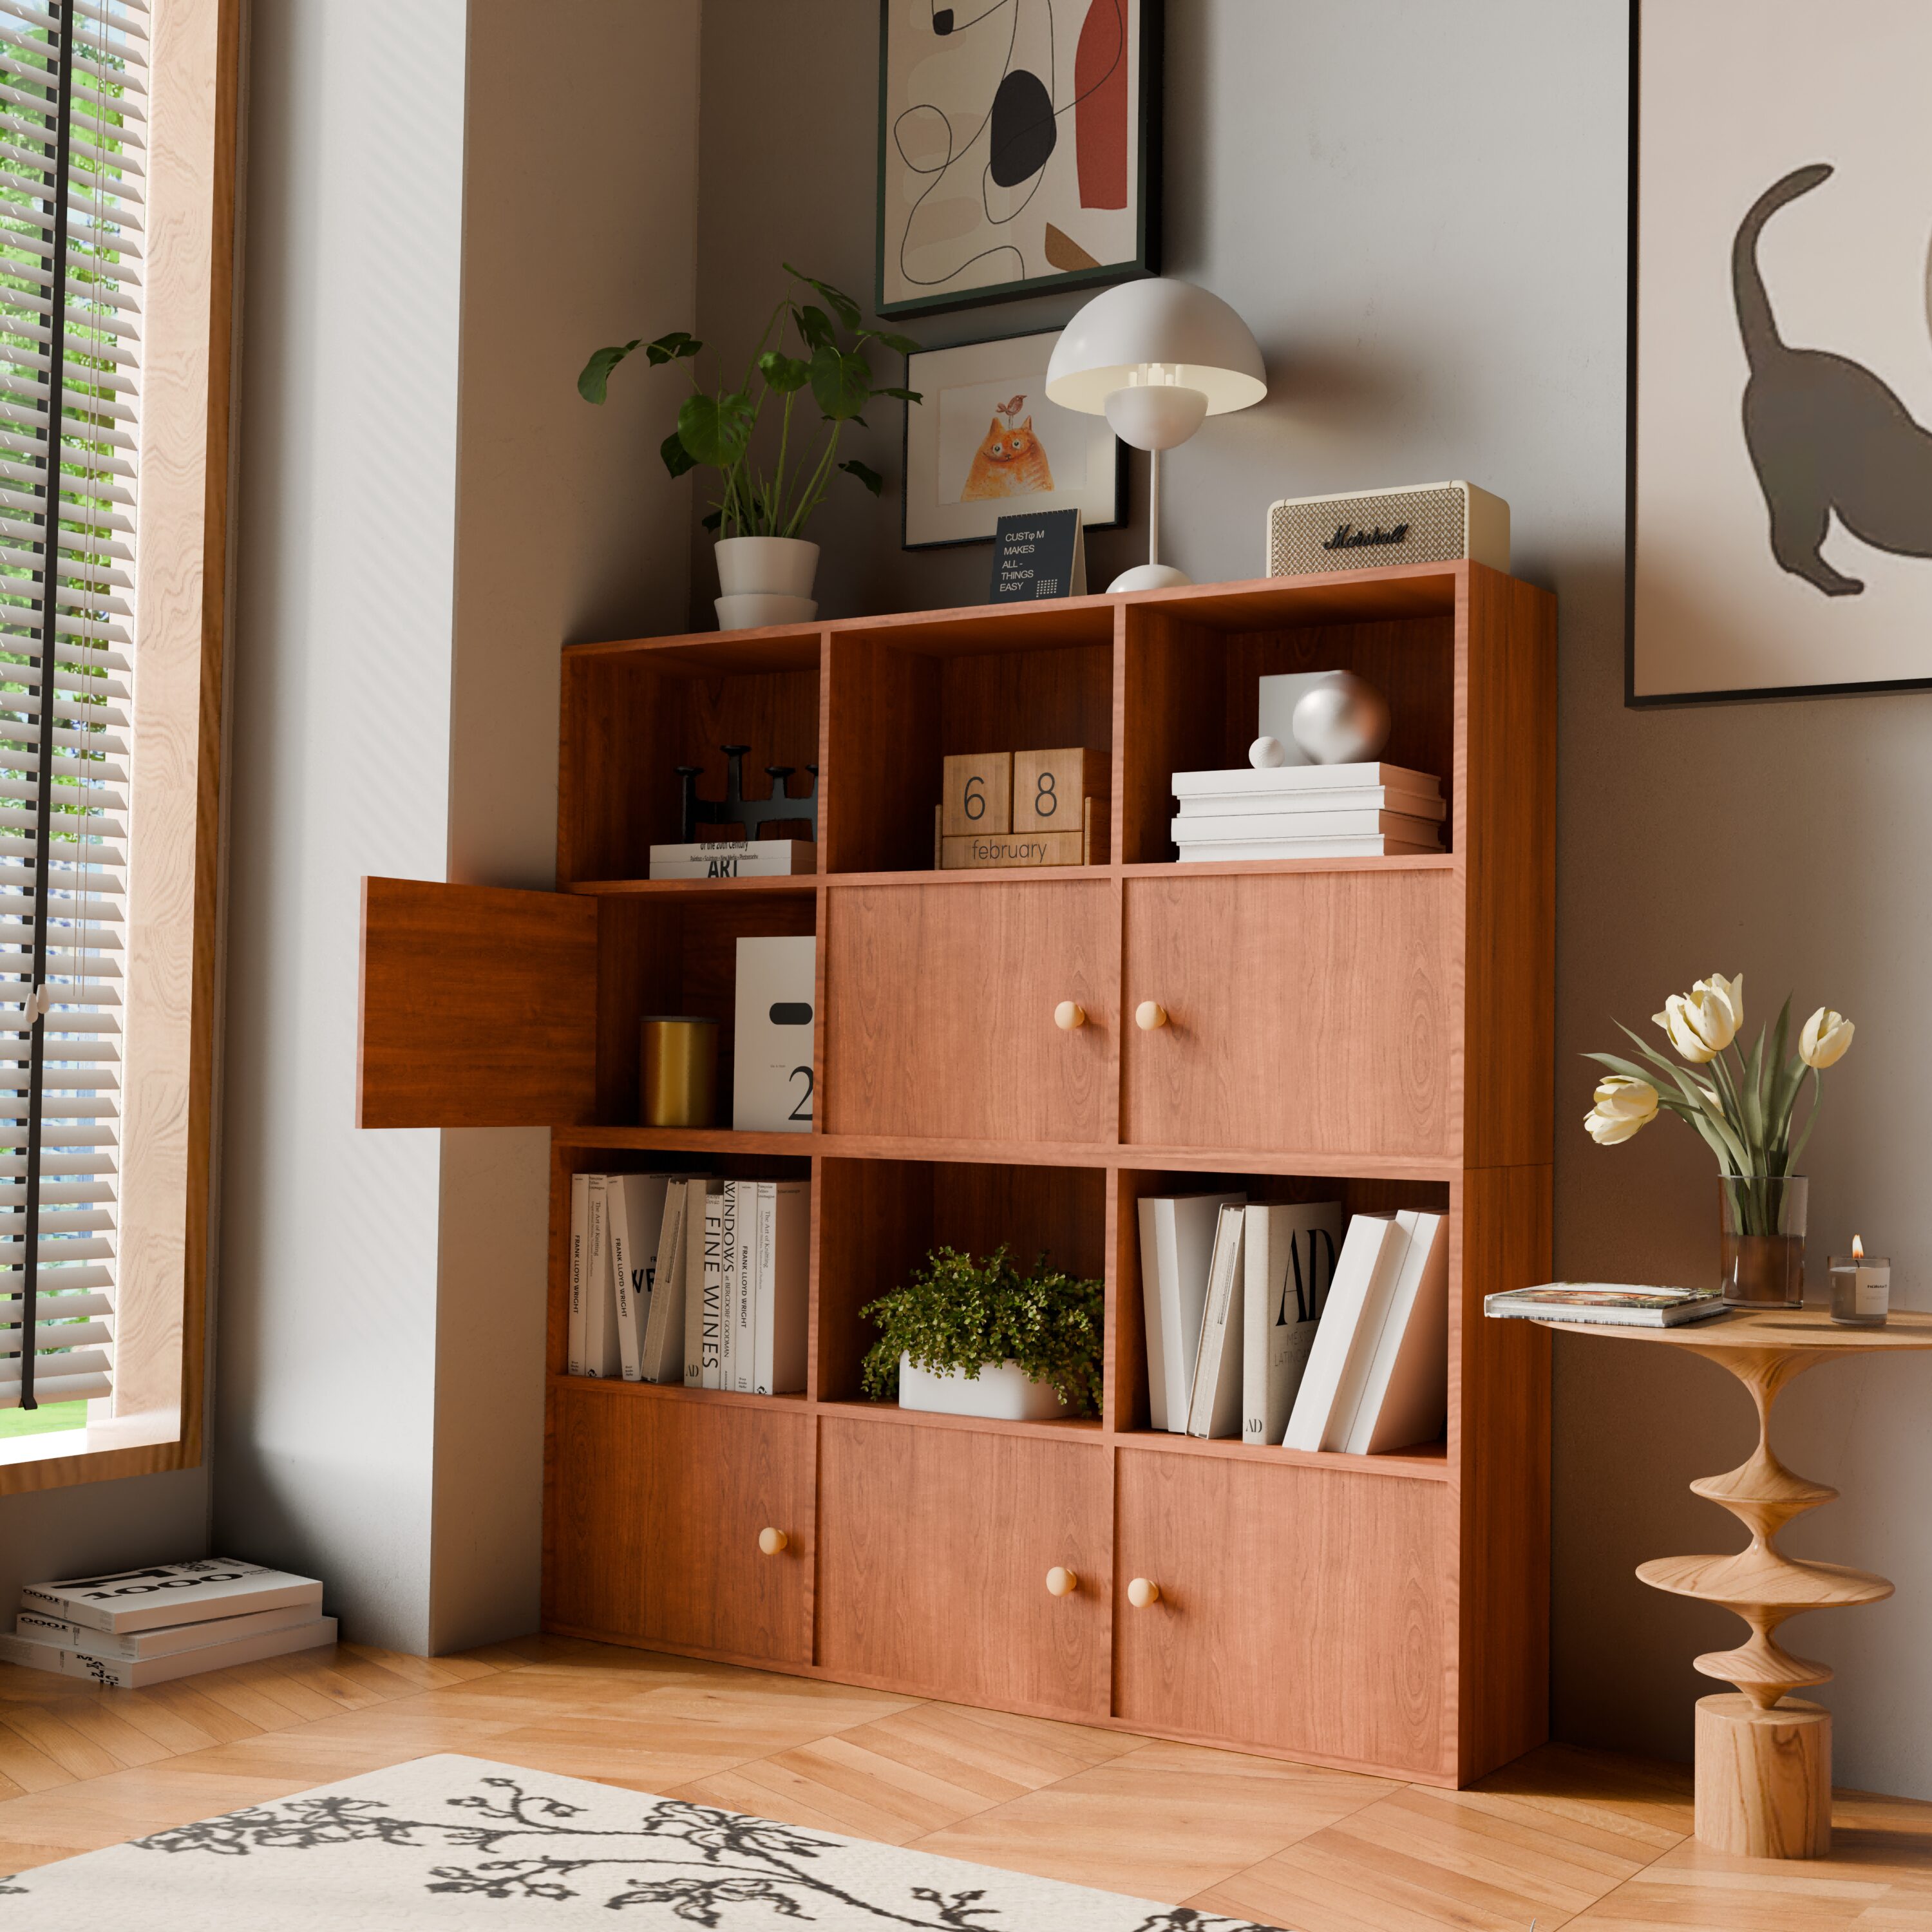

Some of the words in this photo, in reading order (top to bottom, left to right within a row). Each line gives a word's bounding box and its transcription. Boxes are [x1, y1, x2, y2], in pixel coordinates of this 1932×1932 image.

[1003, 545, 1035, 555] MAKES
[1323, 524, 1408, 550] Marshall
[1001, 570, 1034, 580] THINGS
[1002, 560, 1018, 569] ALL
[999, 582, 1024, 592] EASY
[964, 776, 985, 820] 6
[1035, 772, 1057, 817] 8
[972, 839, 1047, 863] february
[788, 1066, 813, 1121] 2
[723, 1182, 735, 1272] WINDOWS
[704, 1217, 721, 1272] FINE
[1275, 1229, 1336, 1326] AD
[703, 1285, 719, 1368] WINES
[1245, 1418, 1262, 1434] AD
[80, 1573, 243, 1600] 1000
